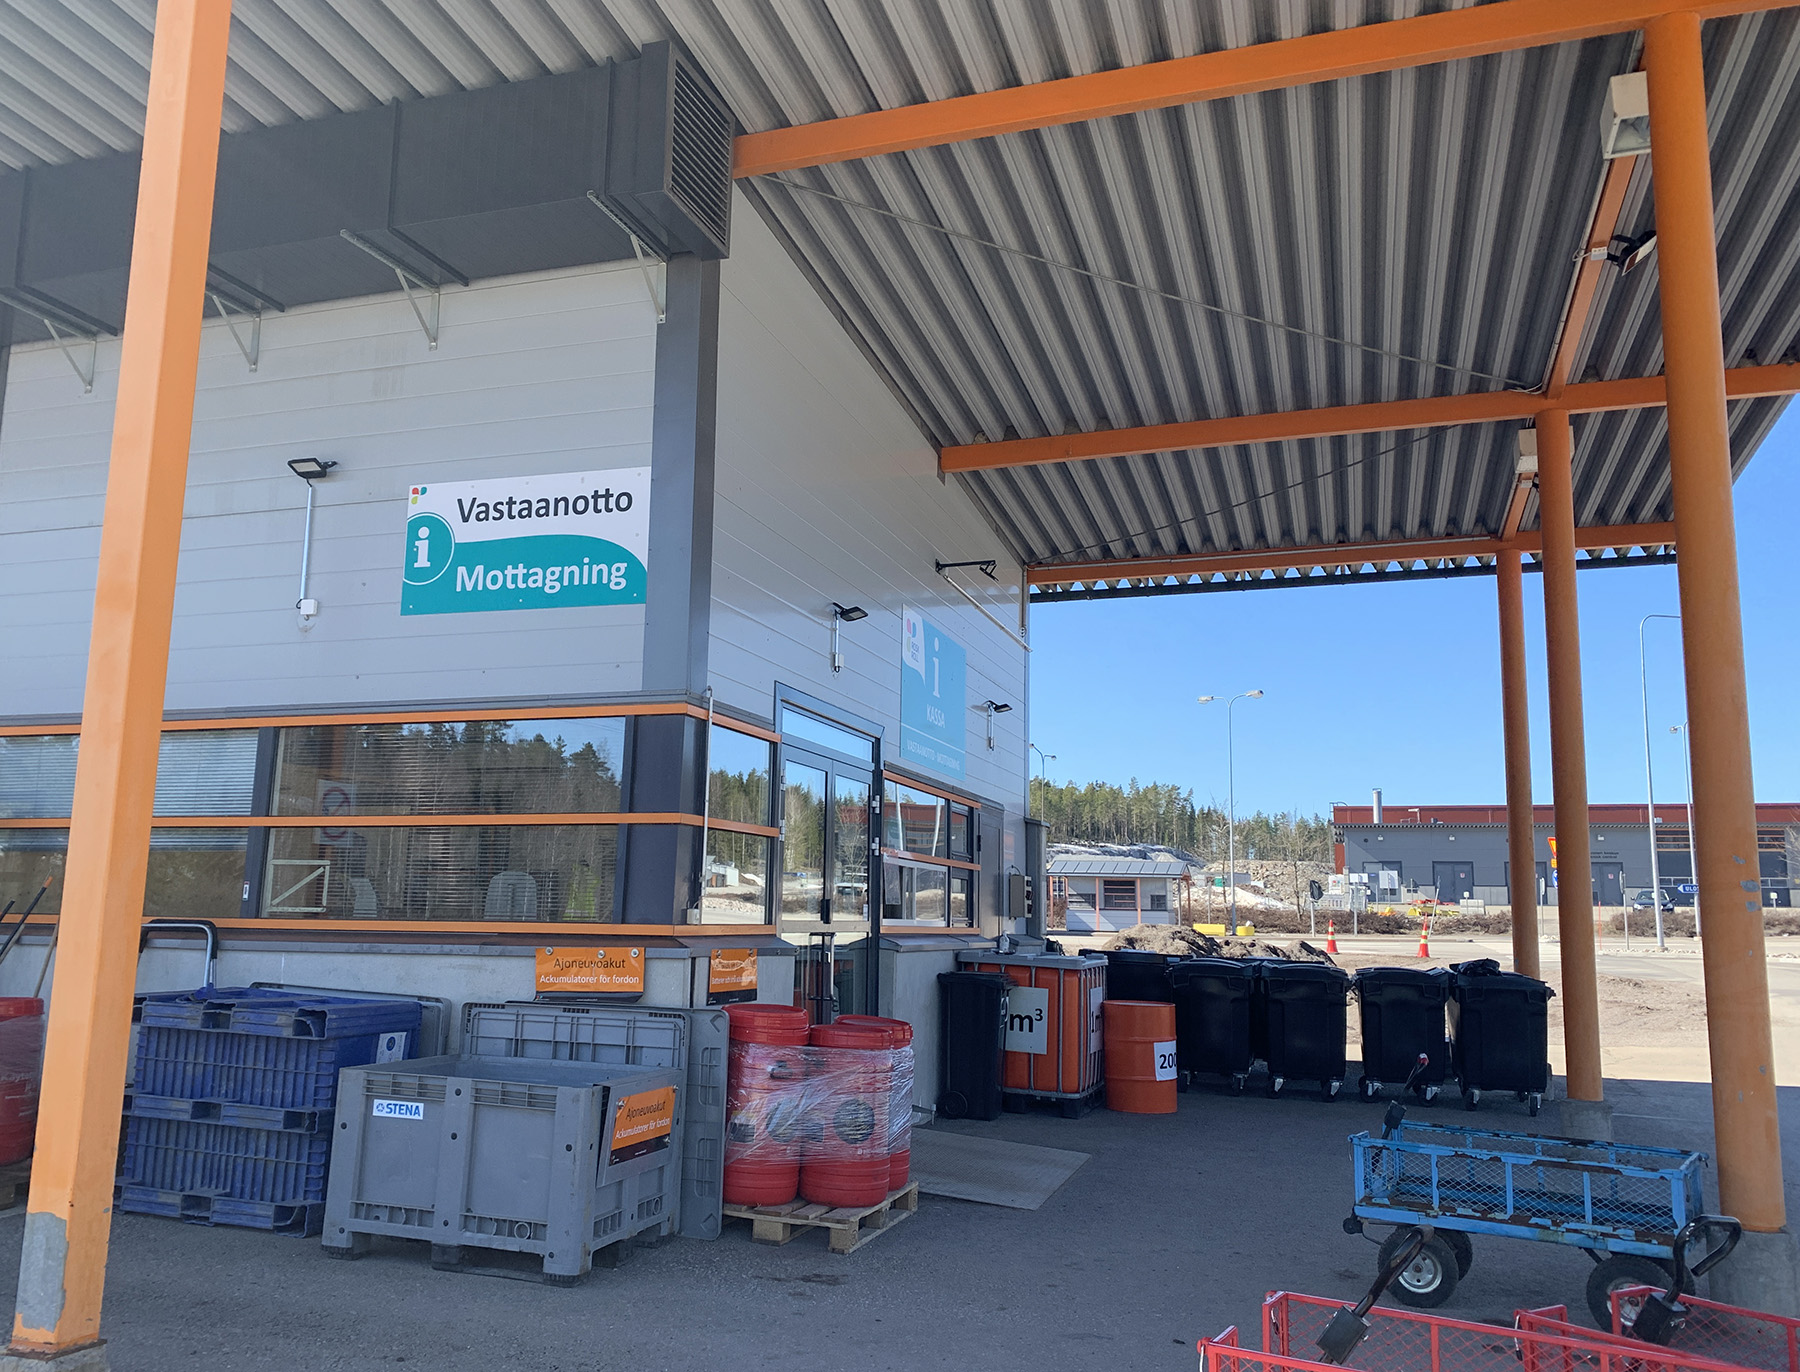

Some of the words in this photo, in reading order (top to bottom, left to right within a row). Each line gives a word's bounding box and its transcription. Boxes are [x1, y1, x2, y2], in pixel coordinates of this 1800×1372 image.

[457, 488, 633, 523] Vastaanotto
[456, 557, 628, 594] Mottagning
[926, 703, 945, 728] KASSA
[553, 957, 627, 971] Ajoneuvoakut
[539, 974, 598, 984] Ackumulatorer
[599, 974, 611, 984] för
[612, 974, 640, 984] fordon
[385, 1102, 421, 1117] STENA
[626, 1100, 665, 1121] Ajoneuvoakut
[615, 1123, 648, 1139] Ackumulatorer
[649, 1120, 657, 1130] för
[657, 1117, 671, 1128] fordon
